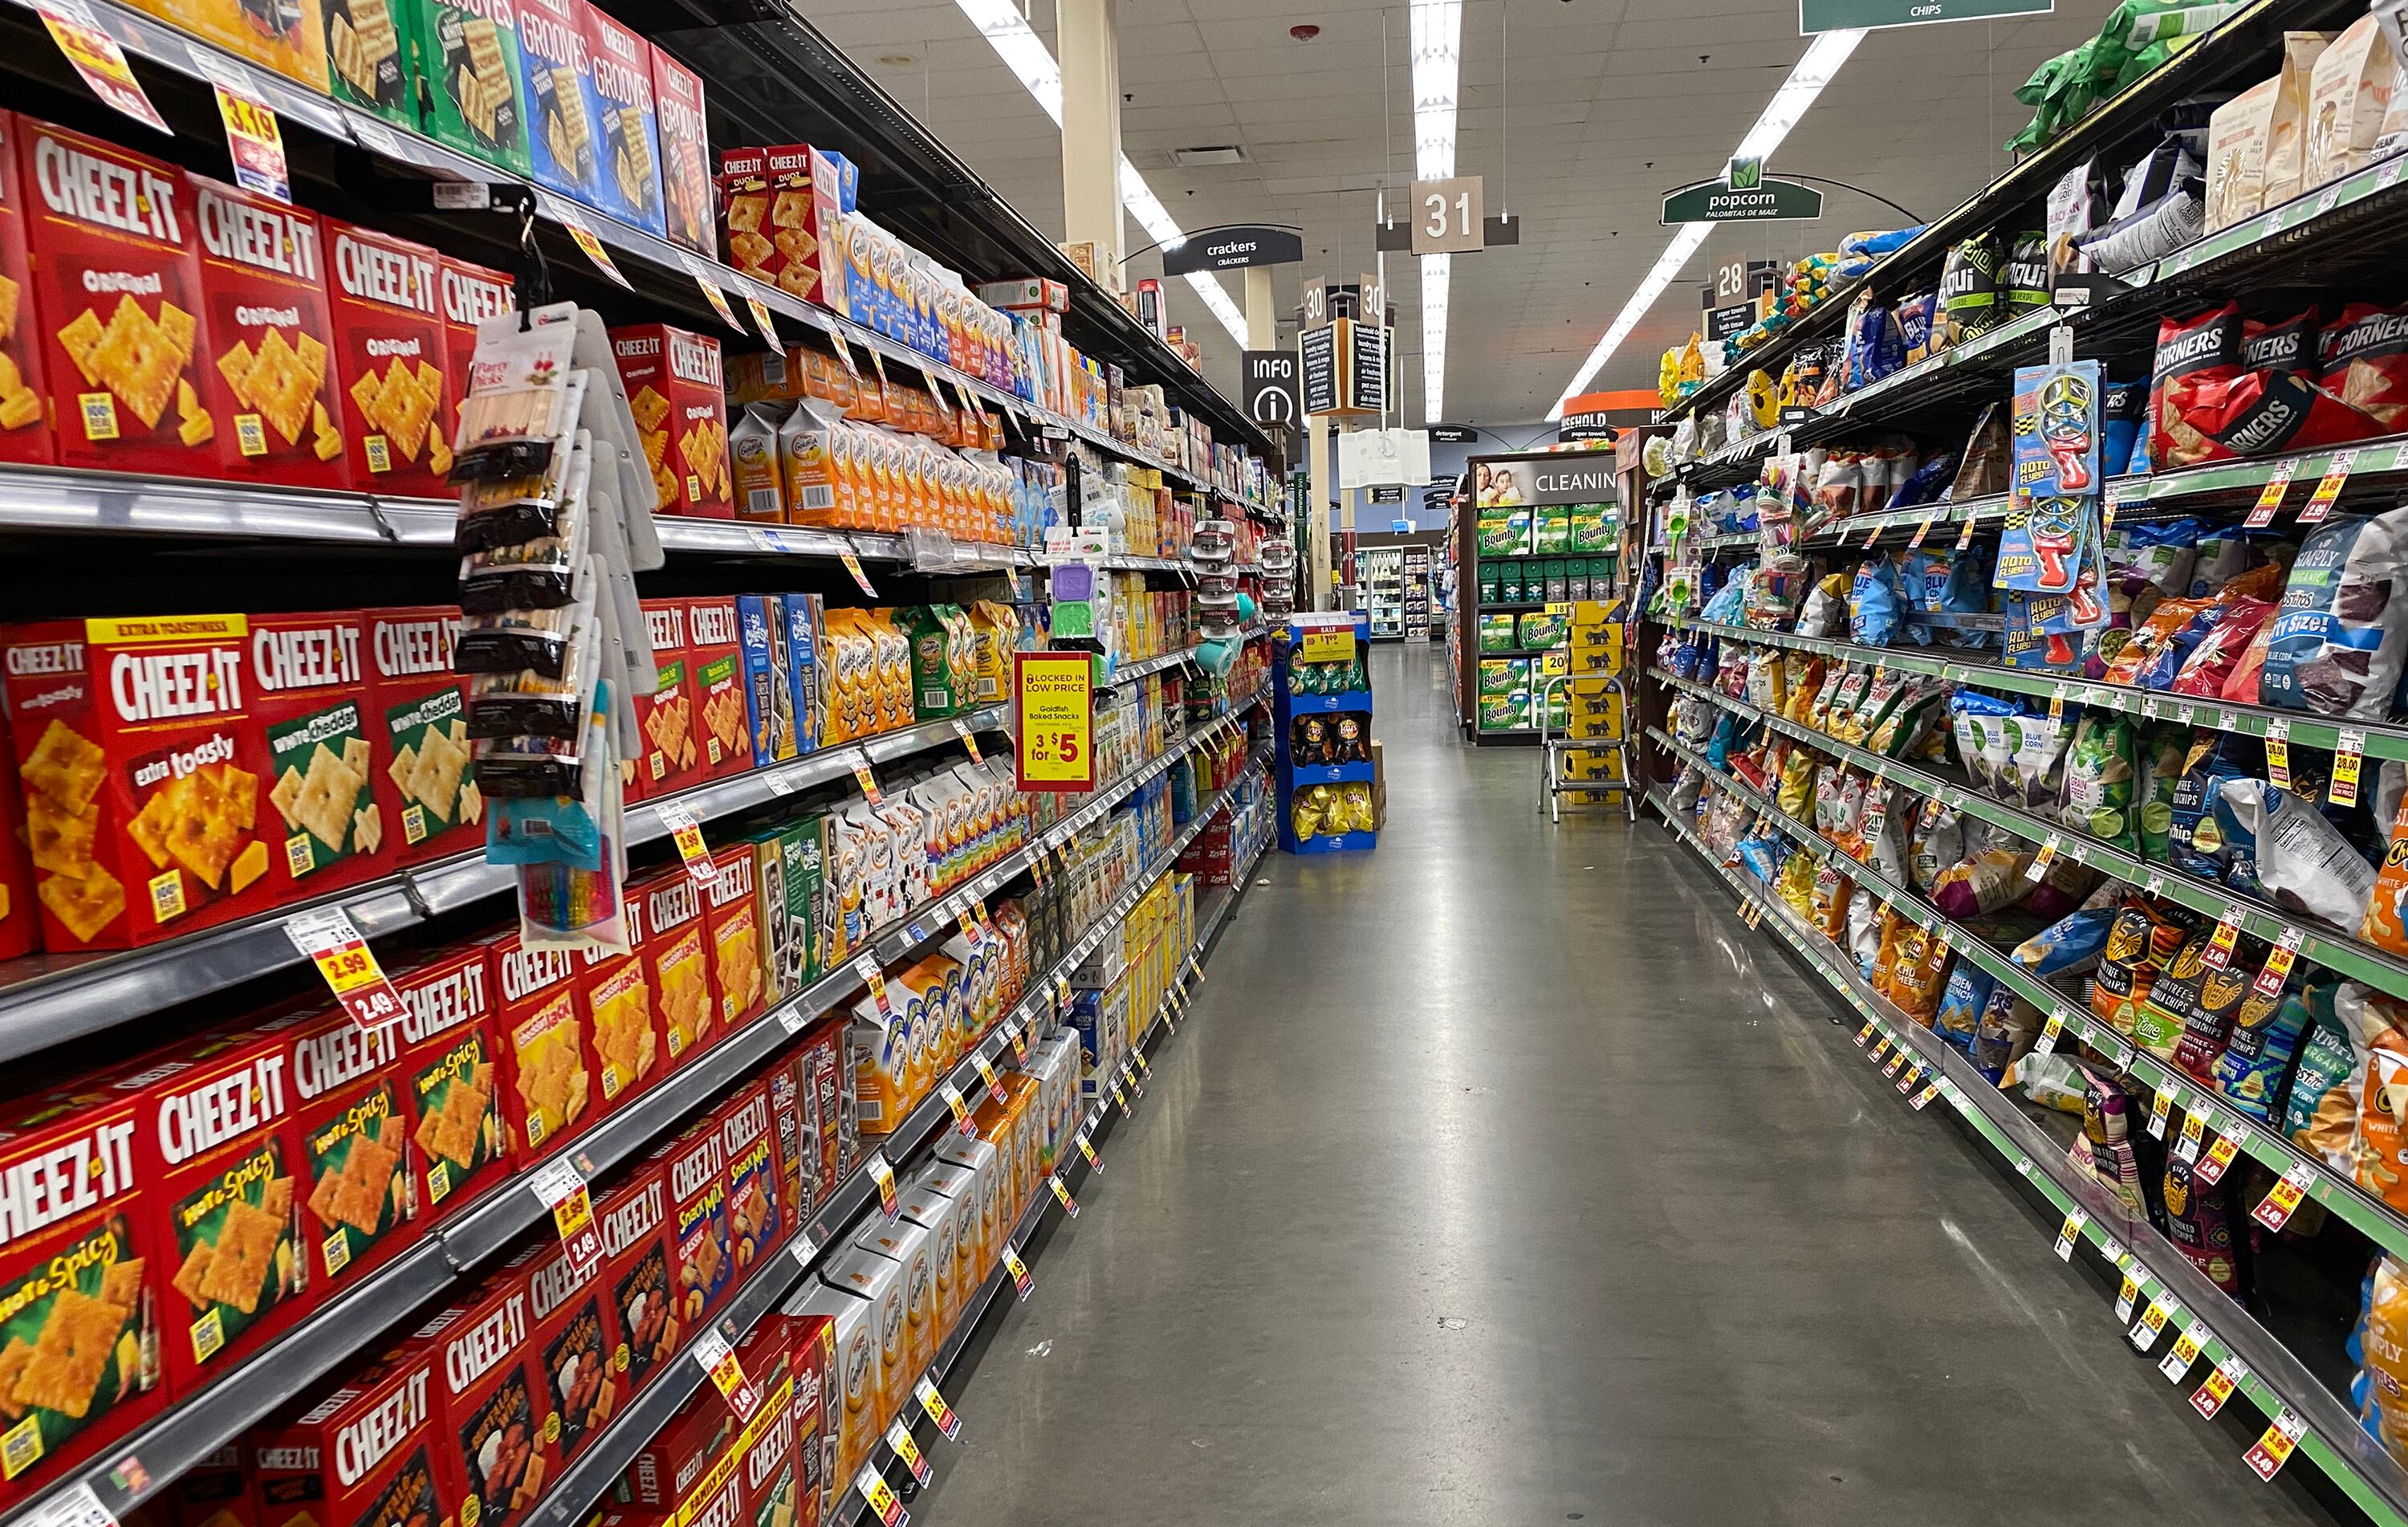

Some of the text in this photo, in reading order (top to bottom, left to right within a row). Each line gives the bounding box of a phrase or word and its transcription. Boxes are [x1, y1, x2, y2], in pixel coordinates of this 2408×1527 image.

[1910, 4, 1942, 16] CHIPS
[521, 10, 590, 76] GROOVES
[592, 55, 653, 115] GROOVES
[734, 175, 755, 186] DUOZ
[779, 172, 800, 183] DUOZ
[1709, 193, 1775, 210] popcorn
[1424, 191, 1470, 238] 31
[1706, 210, 1747, 218] PALOMITAS
[1206, 241, 1257, 256] crackers
[1719, 263, 1743, 297] 28
[1306, 287, 1323, 320] 30
[1364, 284, 1381, 316] 30
[2018, 293, 2033, 303] VERDE
[2154, 328, 2223, 373] CORNERS
[1253, 359, 1291, 378] INFO
[1435, 430, 1462, 438] detergent
[1536, 470, 1616, 492] CLEANIN
[2020, 471, 2044, 484] FLYER
[2265, 487, 2282, 499] 3.49
[2321, 480, 2340, 492] 3.49
[2251, 509, 2269, 522] 2.99
[2305, 503, 2325, 517] 2.99
[1484, 529, 1516, 548] Bounty
[1579, 524, 1610, 544] Bounty
[2295, 552, 2340, 567] SIMPLY
[1999, 566, 2024, 577] FLYER
[2032, 609, 2055, 625] FLYER
[2288, 615, 2329, 634] Size!
[116, 623, 157, 637] EXTRA
[1527, 623, 1560, 641] Bounty
[2007, 642, 2031, 654] FLYER
[2268, 651, 2292, 661] BLUE CORN
[1035, 674, 1084, 682] LOCKED IN
[1484, 670, 1516, 688] Bounty
[1026, 683, 1084, 692] LOW PRICE
[420, 690, 462, 723] cheddar
[1485, 703, 1516, 723] Bounty
[307, 706, 358, 743] cheddar
[1036, 734, 1044, 748] 3
[1987, 736, 2000, 744] CORN
[2025, 733, 2042, 741] BLUE
[2278, 730, 2288, 739] 5.79
[2025, 739, 2043, 748] CORN
[2268, 744, 2285, 756] 2/8.00
[2351, 743, 2363, 752] 5.79
[135, 733, 234, 786] extra toasty
[1031, 747, 1050, 762] for
[2337, 757, 2357, 771] 2/8.00
[2070, 777, 2087, 790] GRAIN
[2071, 788, 2085, 800] FREE
[2178, 794, 2198, 806] CHIPS
[2341, 789, 2353, 797] PRICE
[680, 833, 698, 850] 2.99
[2377, 876, 2400, 889] WHITE
[2127, 912, 2148, 929] SIETE
[2217, 927, 2234, 942] 3.99
[327, 953, 367, 979] 2.99
[2207, 951, 2225, 965] 3.49
[2272, 953, 2290, 967] 3.99
[2108, 964, 2119, 978] FREE
[2170, 983, 2187, 999] FREE
[2260, 976, 2279, 992] 3.49
[355, 992, 394, 1020] 2.49
[2165, 995, 2189, 1013] CHIPS
[2137, 1015, 2160, 1037] Lime
[2205, 1011, 2218, 1026] FREE
[2207, 1023, 2223, 1038] CHIPS
[445, 1038, 480, 1079] Spicy
[2297, 1090, 2316, 1105] CORN
[347, 1090, 389, 1134] Spicy
[2155, 1098, 2169, 1117] 3.99
[2185, 1118, 2201, 1139] 3.99
[2369, 1122, 2399, 1134] WHITE
[2215, 1142, 2232, 1158] 3.99
[224, 1150, 275, 1200] Spicy
[2173, 1165, 2189, 1182] SIETE
[2201, 1161, 2219, 1178] 3.49
[2276, 1185, 2296, 1203] 3.99
[2260, 1204, 2281, 1224] 3.49
[2064, 1223, 2077, 1241] 4.99
[572, 1232, 596, 1262] 2.49
[49, 1231, 118, 1289] Spicy
[2146, 1308, 2165, 1331] 3.99
[2176, 1339, 2195, 1363] 3.99
[2211, 1374, 2229, 1394] 3.99
[2197, 1392, 2215, 1412] 3.49
[750, 1390, 787, 1439] FAMILY SIZE
[2268, 1431, 2288, 1453] 3.99
[2252, 1450, 2273, 1473] 3.49
[689, 1454, 735, 1513] FAMILY SIZE
